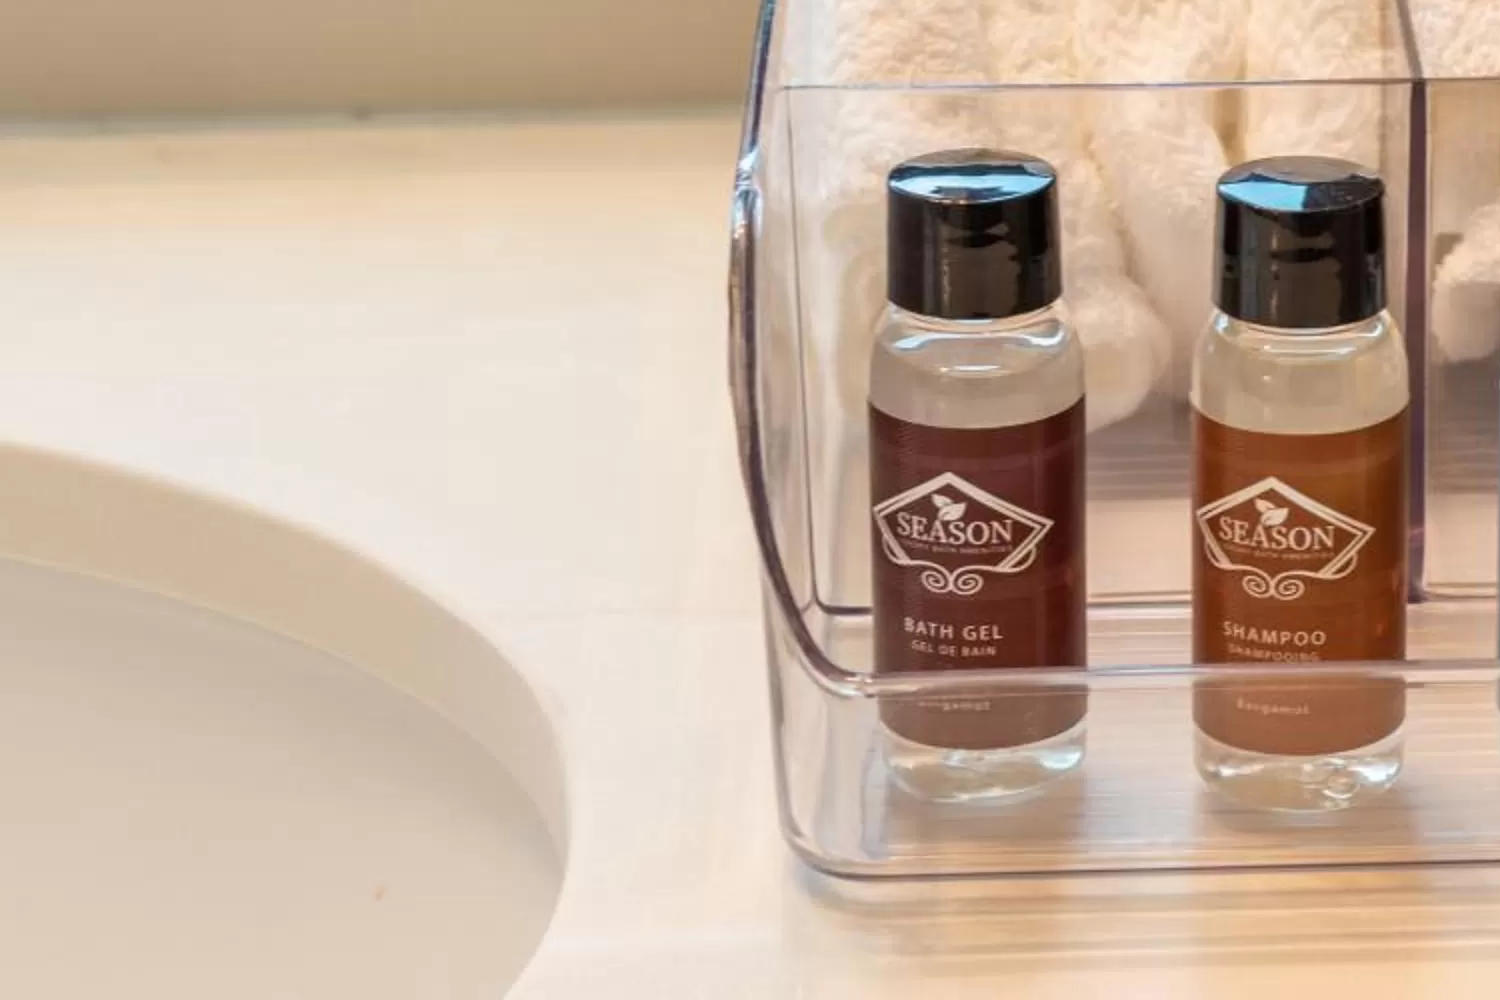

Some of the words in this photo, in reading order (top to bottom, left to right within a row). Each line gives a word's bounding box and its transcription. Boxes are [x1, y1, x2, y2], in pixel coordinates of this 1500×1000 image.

[896, 511, 1014, 545] SEASON
[1218, 515, 1336, 550] SEASON
[903, 616, 954, 640] BATH
[962, 623, 1004, 642] GEL
[1222, 620, 1328, 647] SHAMPOO
[911, 639, 934, 653] GEL
[960, 645, 998, 657] BAIN
